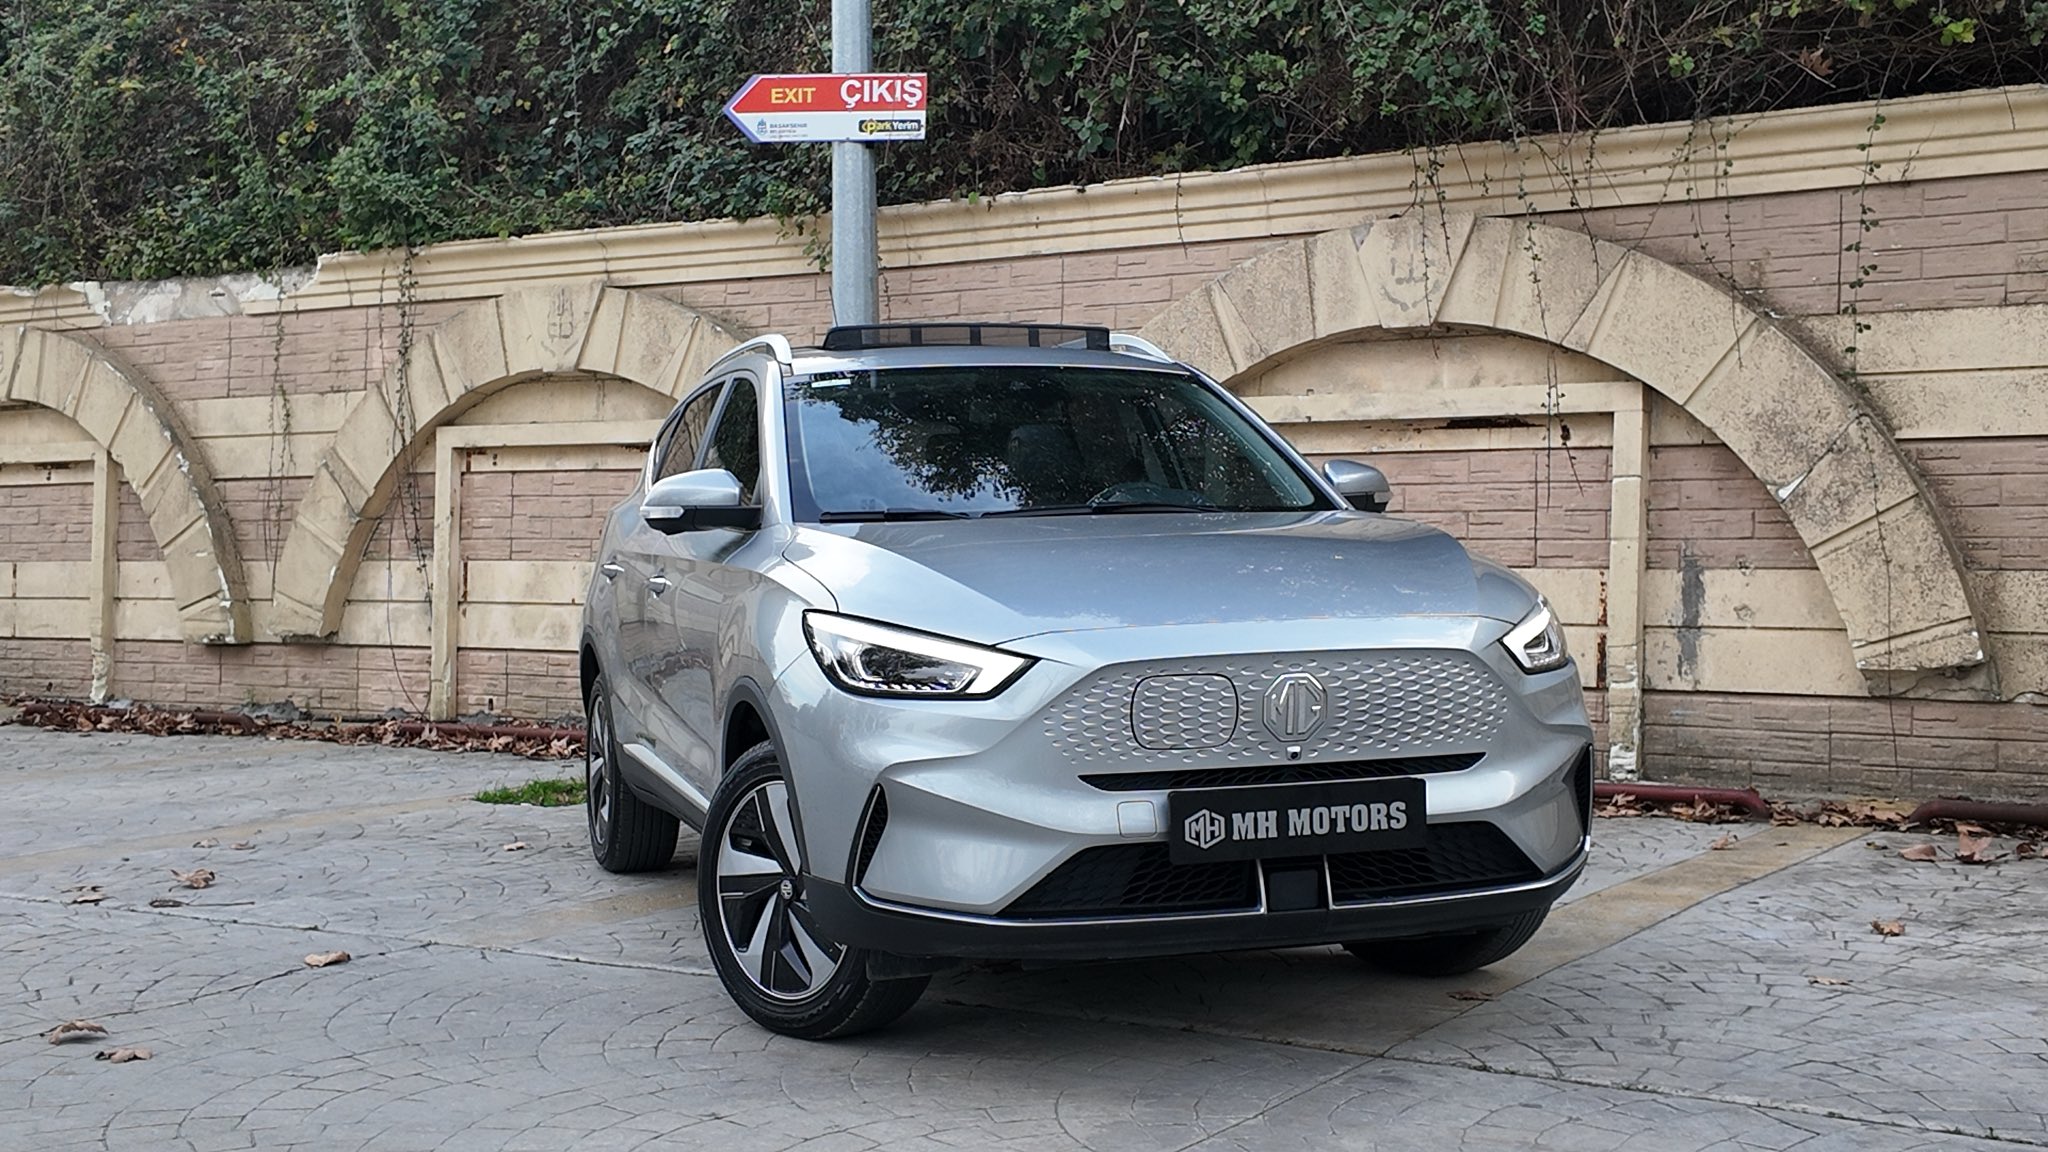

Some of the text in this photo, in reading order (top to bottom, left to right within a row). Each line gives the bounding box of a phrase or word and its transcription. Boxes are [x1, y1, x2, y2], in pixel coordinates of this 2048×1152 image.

[771, 79, 923, 109] EXIT ÇIKIŞ
[1269, 679, 1322, 735] MG
[1232, 810, 1278, 840] MH
[1288, 801, 1407, 837] MOTORS
